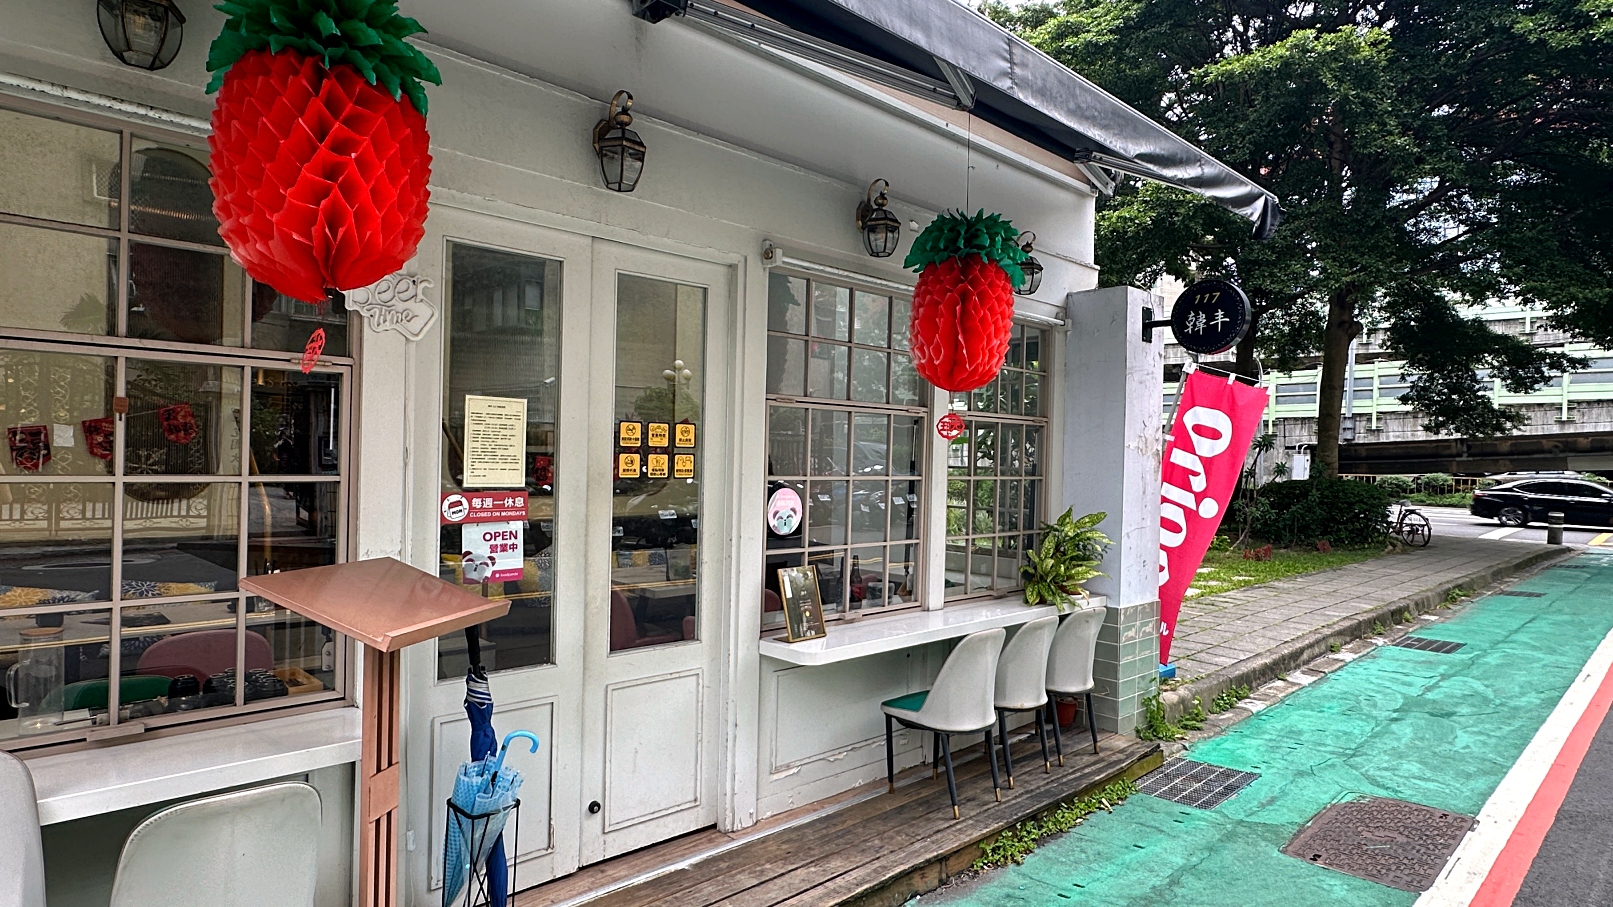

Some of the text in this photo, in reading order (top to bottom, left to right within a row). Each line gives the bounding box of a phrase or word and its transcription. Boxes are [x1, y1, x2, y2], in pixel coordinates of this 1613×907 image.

[1195, 292, 1220, 304] 117
[1159, 406, 1233, 588] Orio
[482, 530, 518, 542] OPEN
